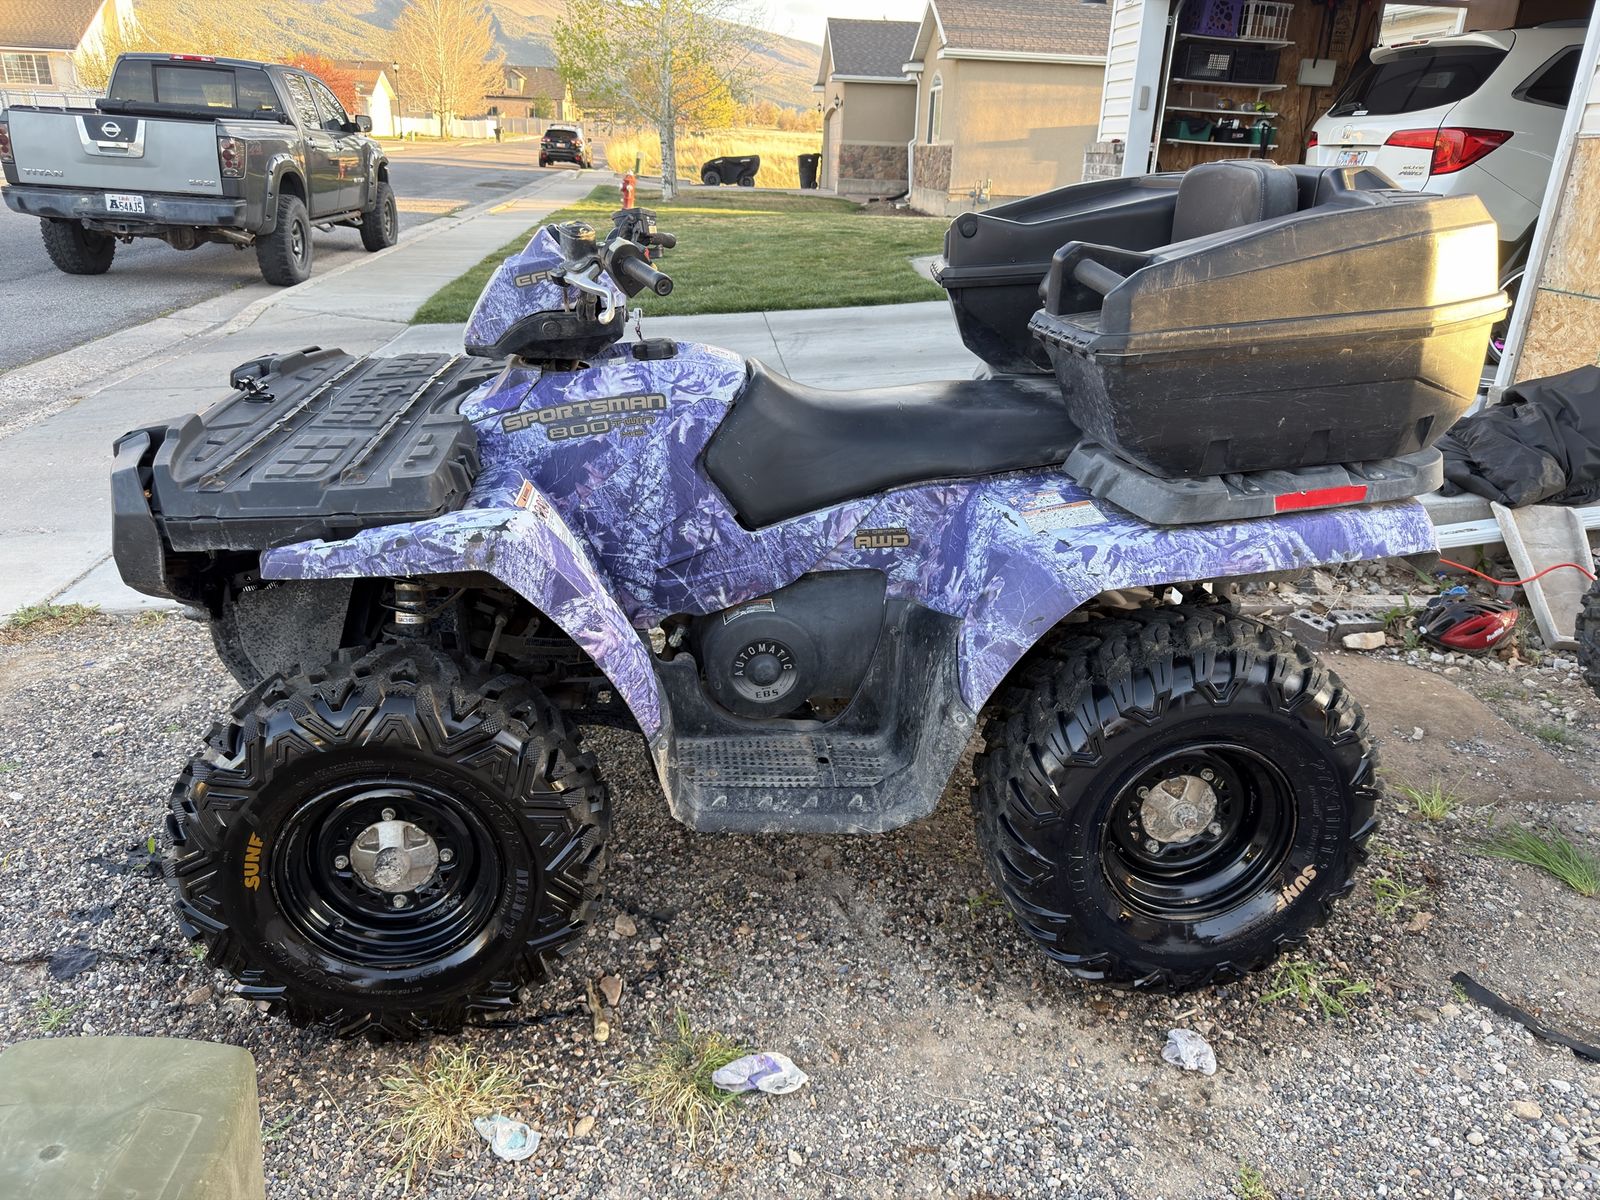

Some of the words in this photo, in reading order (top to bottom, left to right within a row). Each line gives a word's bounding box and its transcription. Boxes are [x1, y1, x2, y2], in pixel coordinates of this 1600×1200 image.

[22, 167, 64, 178] TITAN
[503, 395, 665, 432] SPORTSMAN
[549, 420, 610, 439] 800
[854, 534, 910, 549] AWD
[734, 643, 793, 677] AUTOMATIC
[755, 689, 779, 699] EBS
